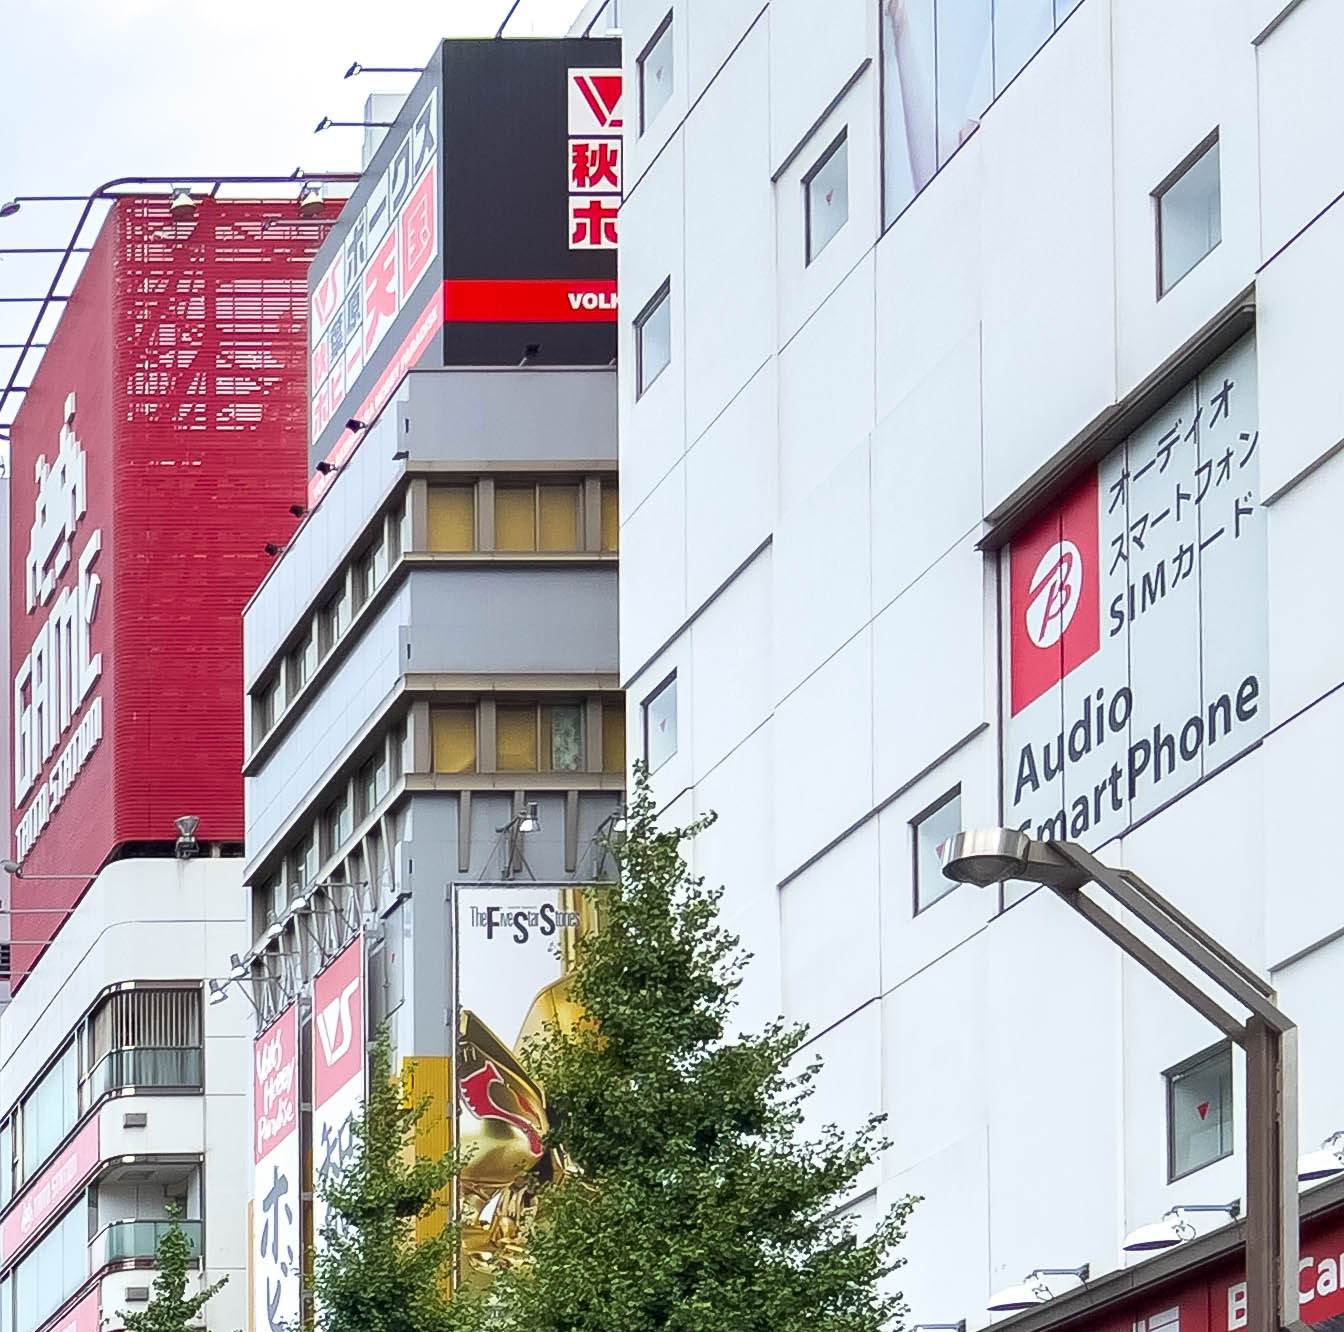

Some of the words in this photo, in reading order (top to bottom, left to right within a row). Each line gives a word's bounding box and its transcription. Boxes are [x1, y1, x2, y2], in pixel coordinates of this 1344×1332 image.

[573, 143, 617, 189] 秋
[1107, 378, 1234, 514] オーディオ
[1108, 430, 1260, 577] スマートフォン
[1108, 491, 1255, 638] SIMカード
[1013, 684, 1133, 807] Audio
[1018, 673, 1260, 845] SmartPhone
